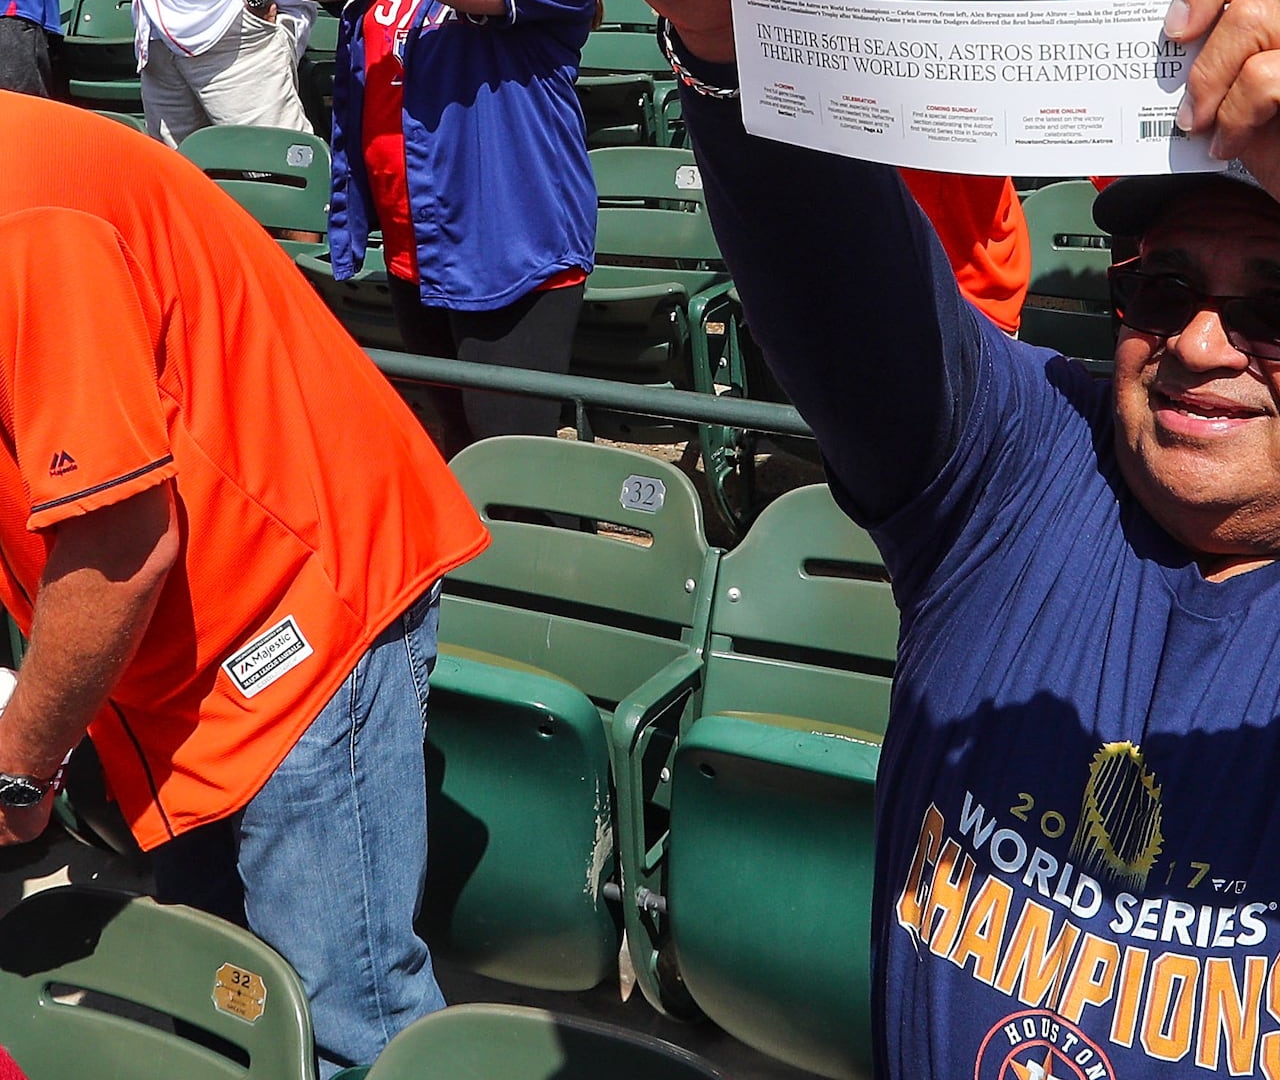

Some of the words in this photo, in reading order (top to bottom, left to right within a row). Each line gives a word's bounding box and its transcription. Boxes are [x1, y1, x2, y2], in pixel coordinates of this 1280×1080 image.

[986, 11, 1014, 19] Bregman
[757, 23, 772, 41] IN
[773, 26, 819, 49] THEIR
[821, 35, 860, 54] 56TH
[864, 38, 944, 61] SEASON,
[948, 42, 1033, 62] ASTROS
[1039, 41, 1110, 61] BRING
[1116, 39, 1187, 58] HOME
[760, 42, 804, 64] THEIR
[807, 49, 850, 72] FIRST
[853, 56, 920, 79] WORLD
[924, 63, 997, 82] SERIES
[1001, 60, 1183, 82] CHAMPIONSHIP
[295, 148, 305, 163] 5
[686, 169, 696, 185] 3
[630, 481, 656, 506] 32
[251, 633, 292, 664] Majestic
[958, 790, 1104, 921] WORLD
[1109, 891, 1266, 949] SERIES
[231, 971, 251, 989] 32
[1003, 1017, 1107, 1080] HOUSTON
